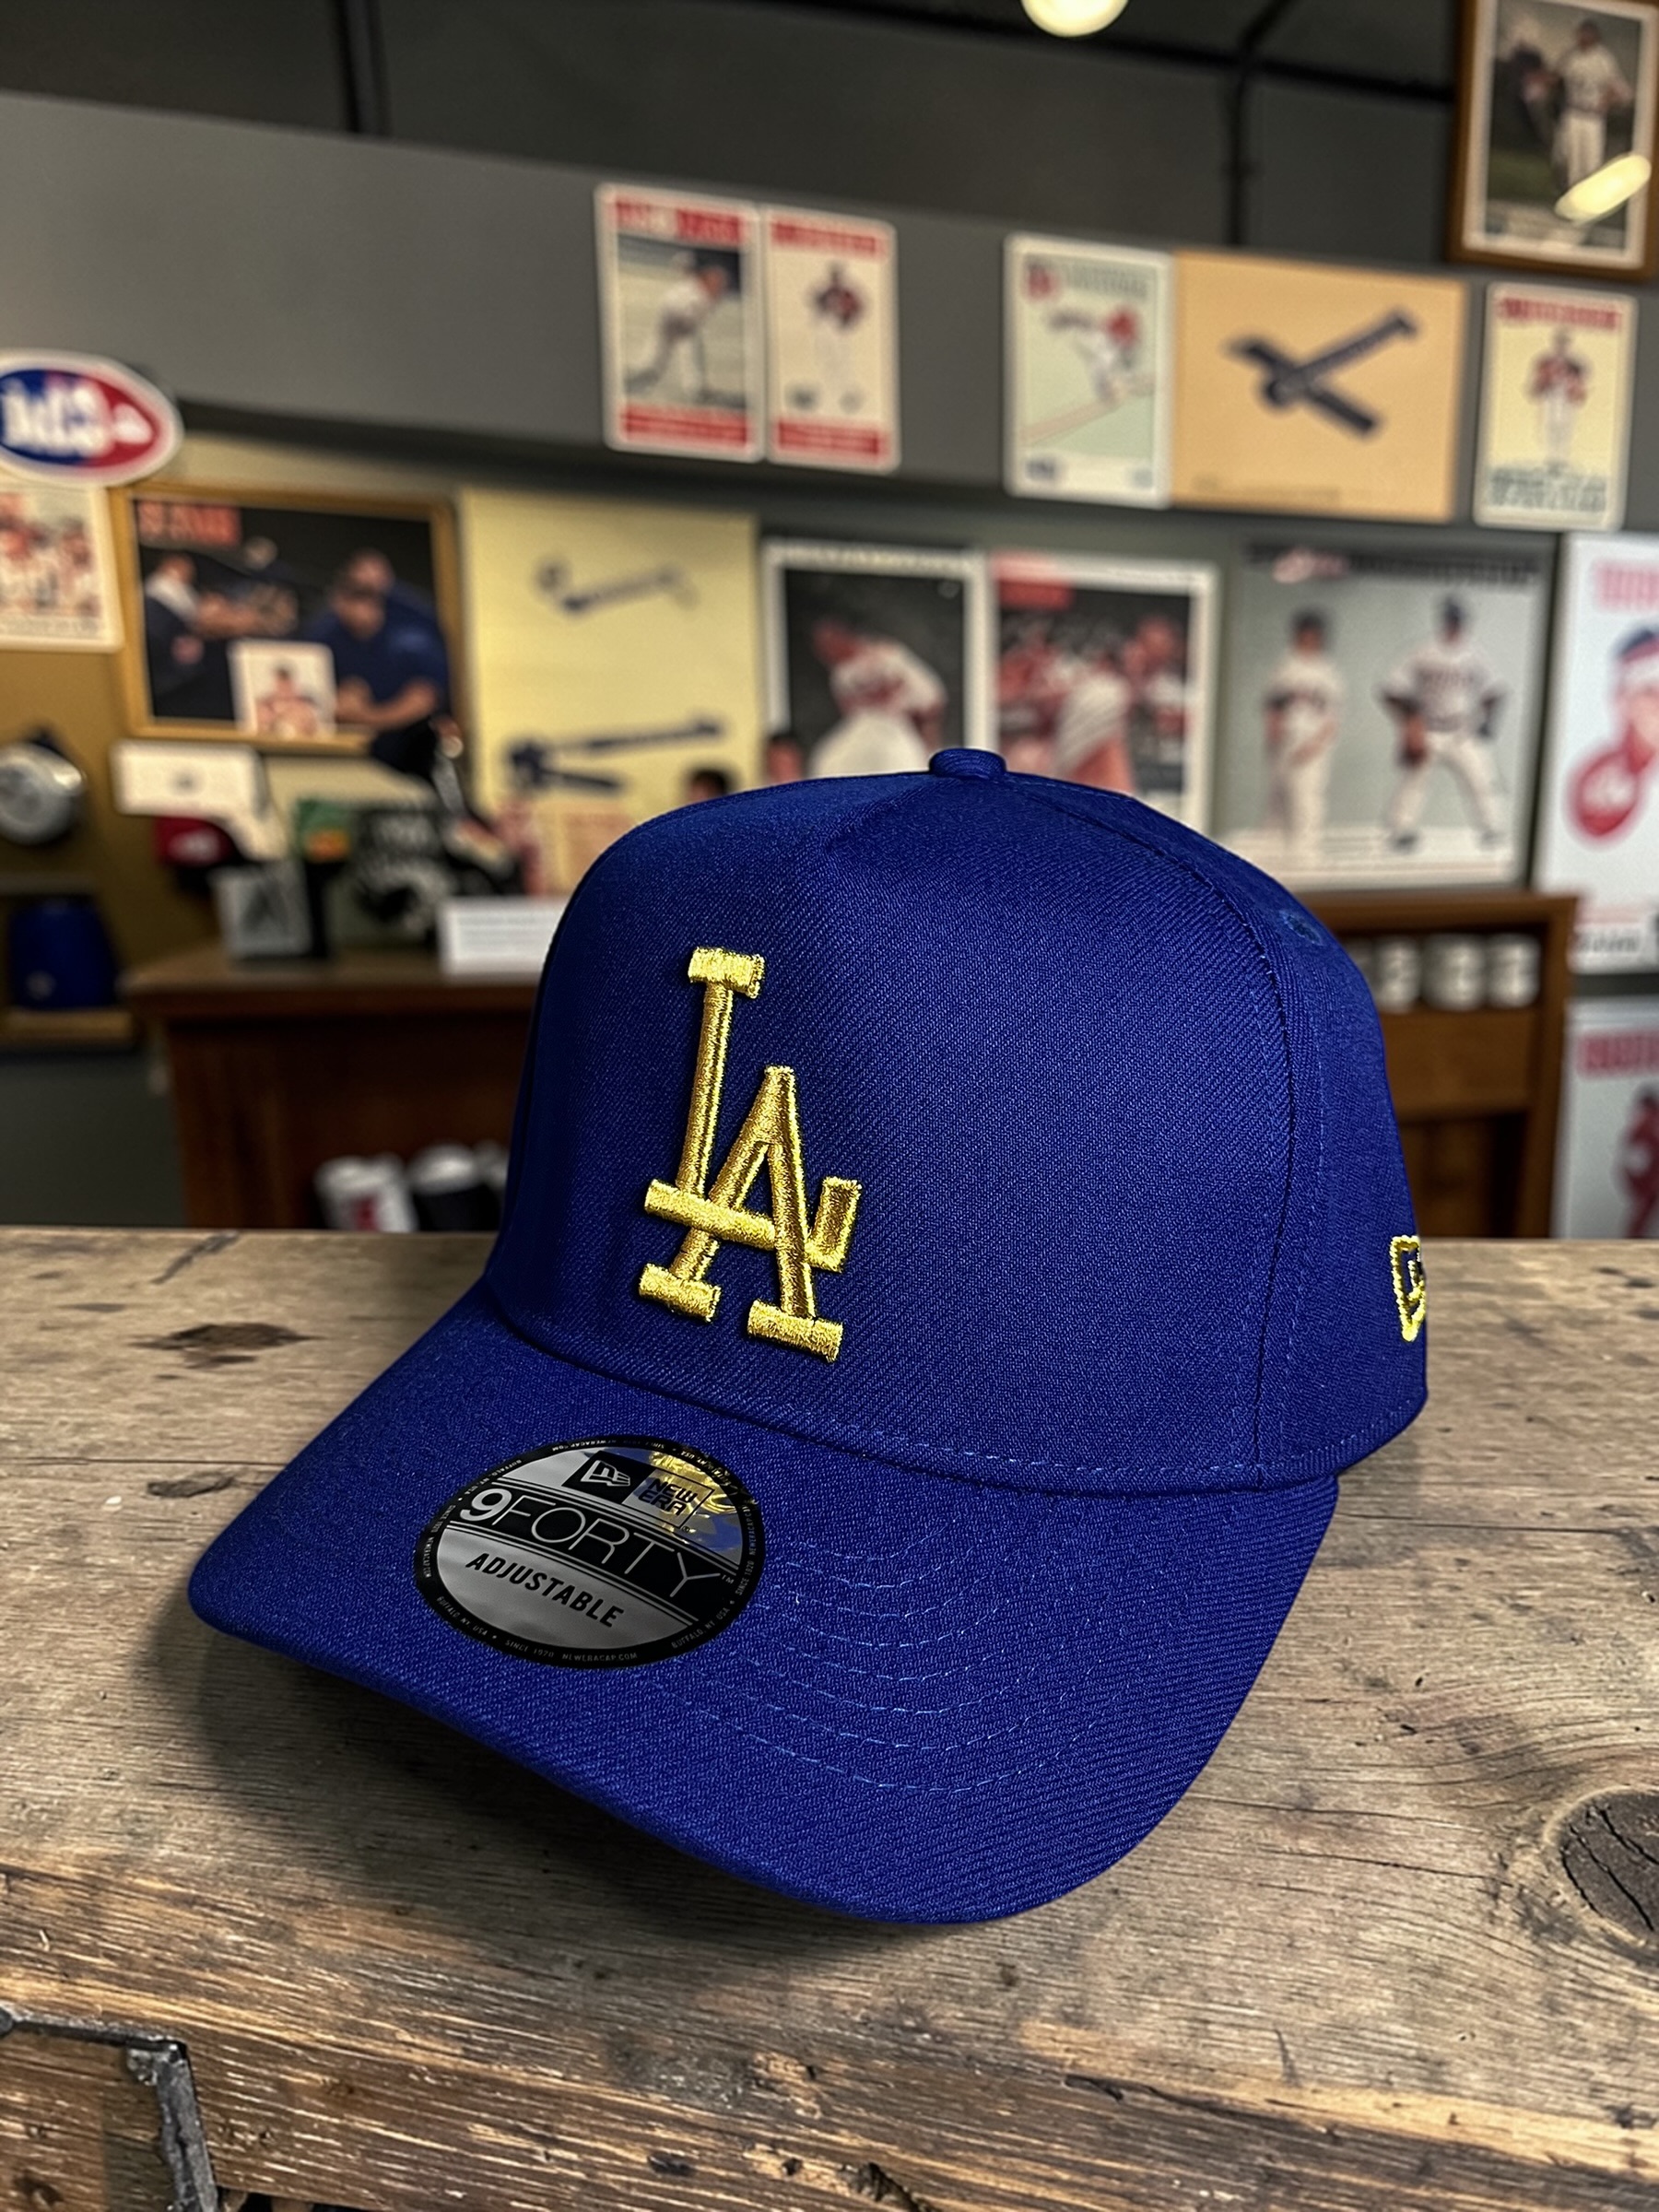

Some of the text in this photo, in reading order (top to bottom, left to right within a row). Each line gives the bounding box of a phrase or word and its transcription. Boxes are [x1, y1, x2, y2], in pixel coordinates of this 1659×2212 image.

[640, 947, 862, 1362] LA
[638, 1488, 687, 1516] ERA
[647, 1477, 699, 1503] NEW
[465, 1552, 625, 1628] ADJUSTABLE
